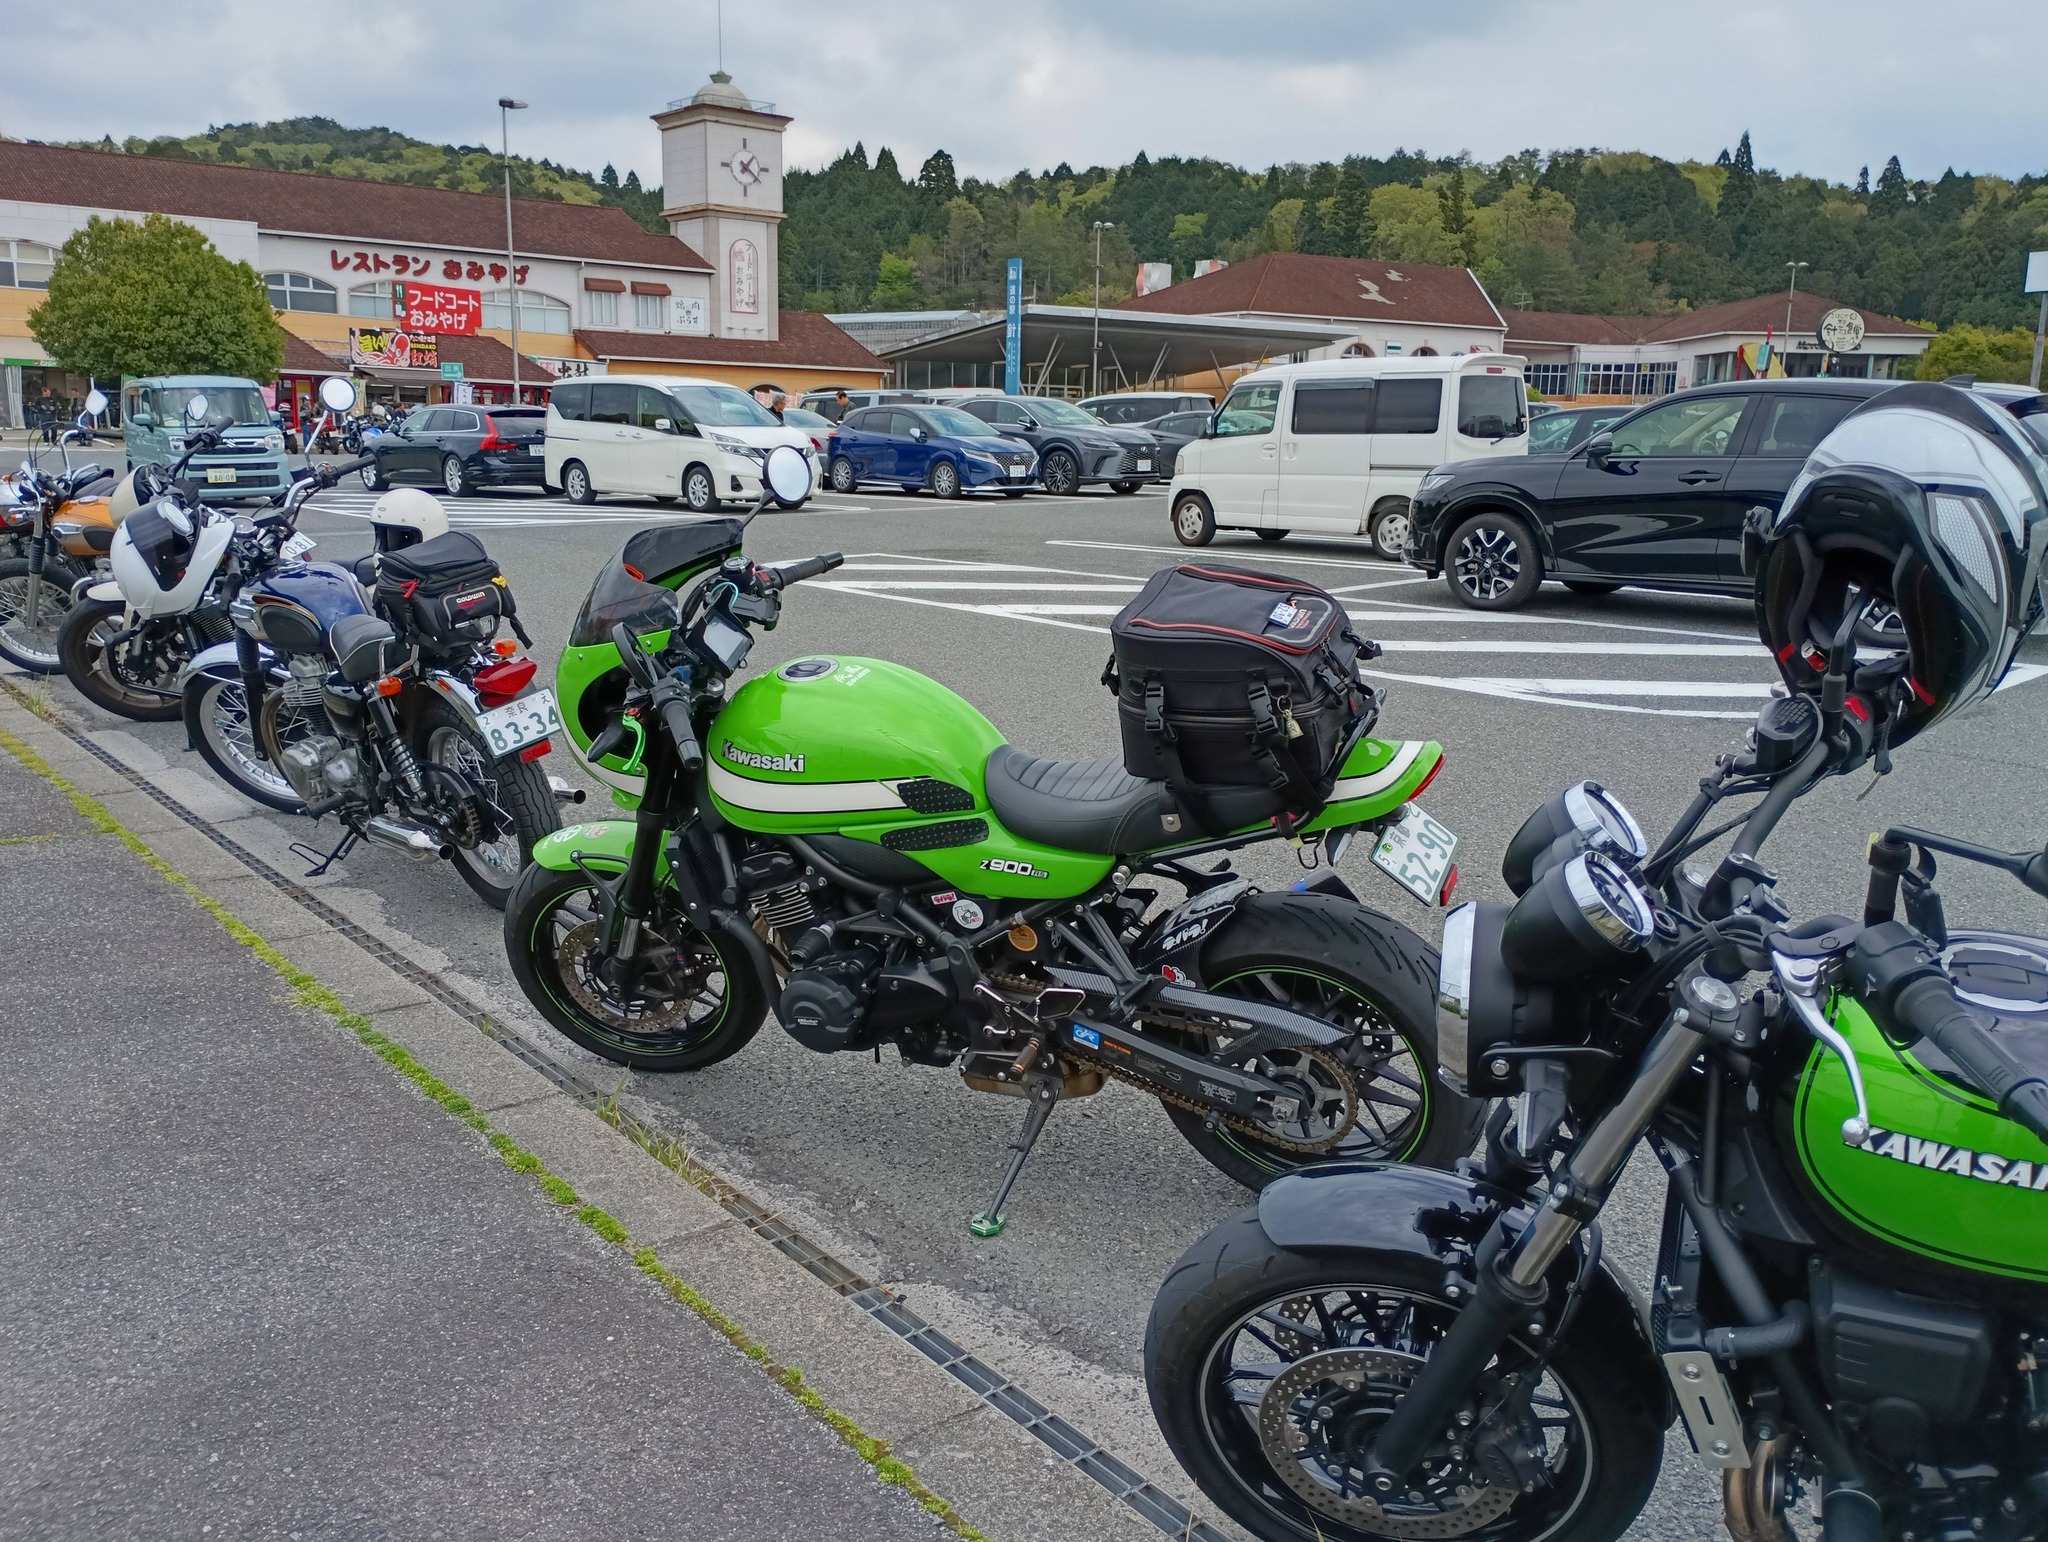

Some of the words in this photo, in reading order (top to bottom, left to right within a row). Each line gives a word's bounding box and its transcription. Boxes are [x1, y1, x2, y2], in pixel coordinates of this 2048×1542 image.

[331, 250, 430, 276] レストラン
[443, 259, 530, 285] おみやげ
[409, 289, 479, 313] フードコート
[410, 308, 468, 331] おみやげ
[483, 716, 491, 726] 2
[504, 702, 529, 718] 奈良
[490, 706, 559, 751] 83-34
[721, 739, 805, 773] Kawasaki
[1399, 819, 1454, 896] 52-90
